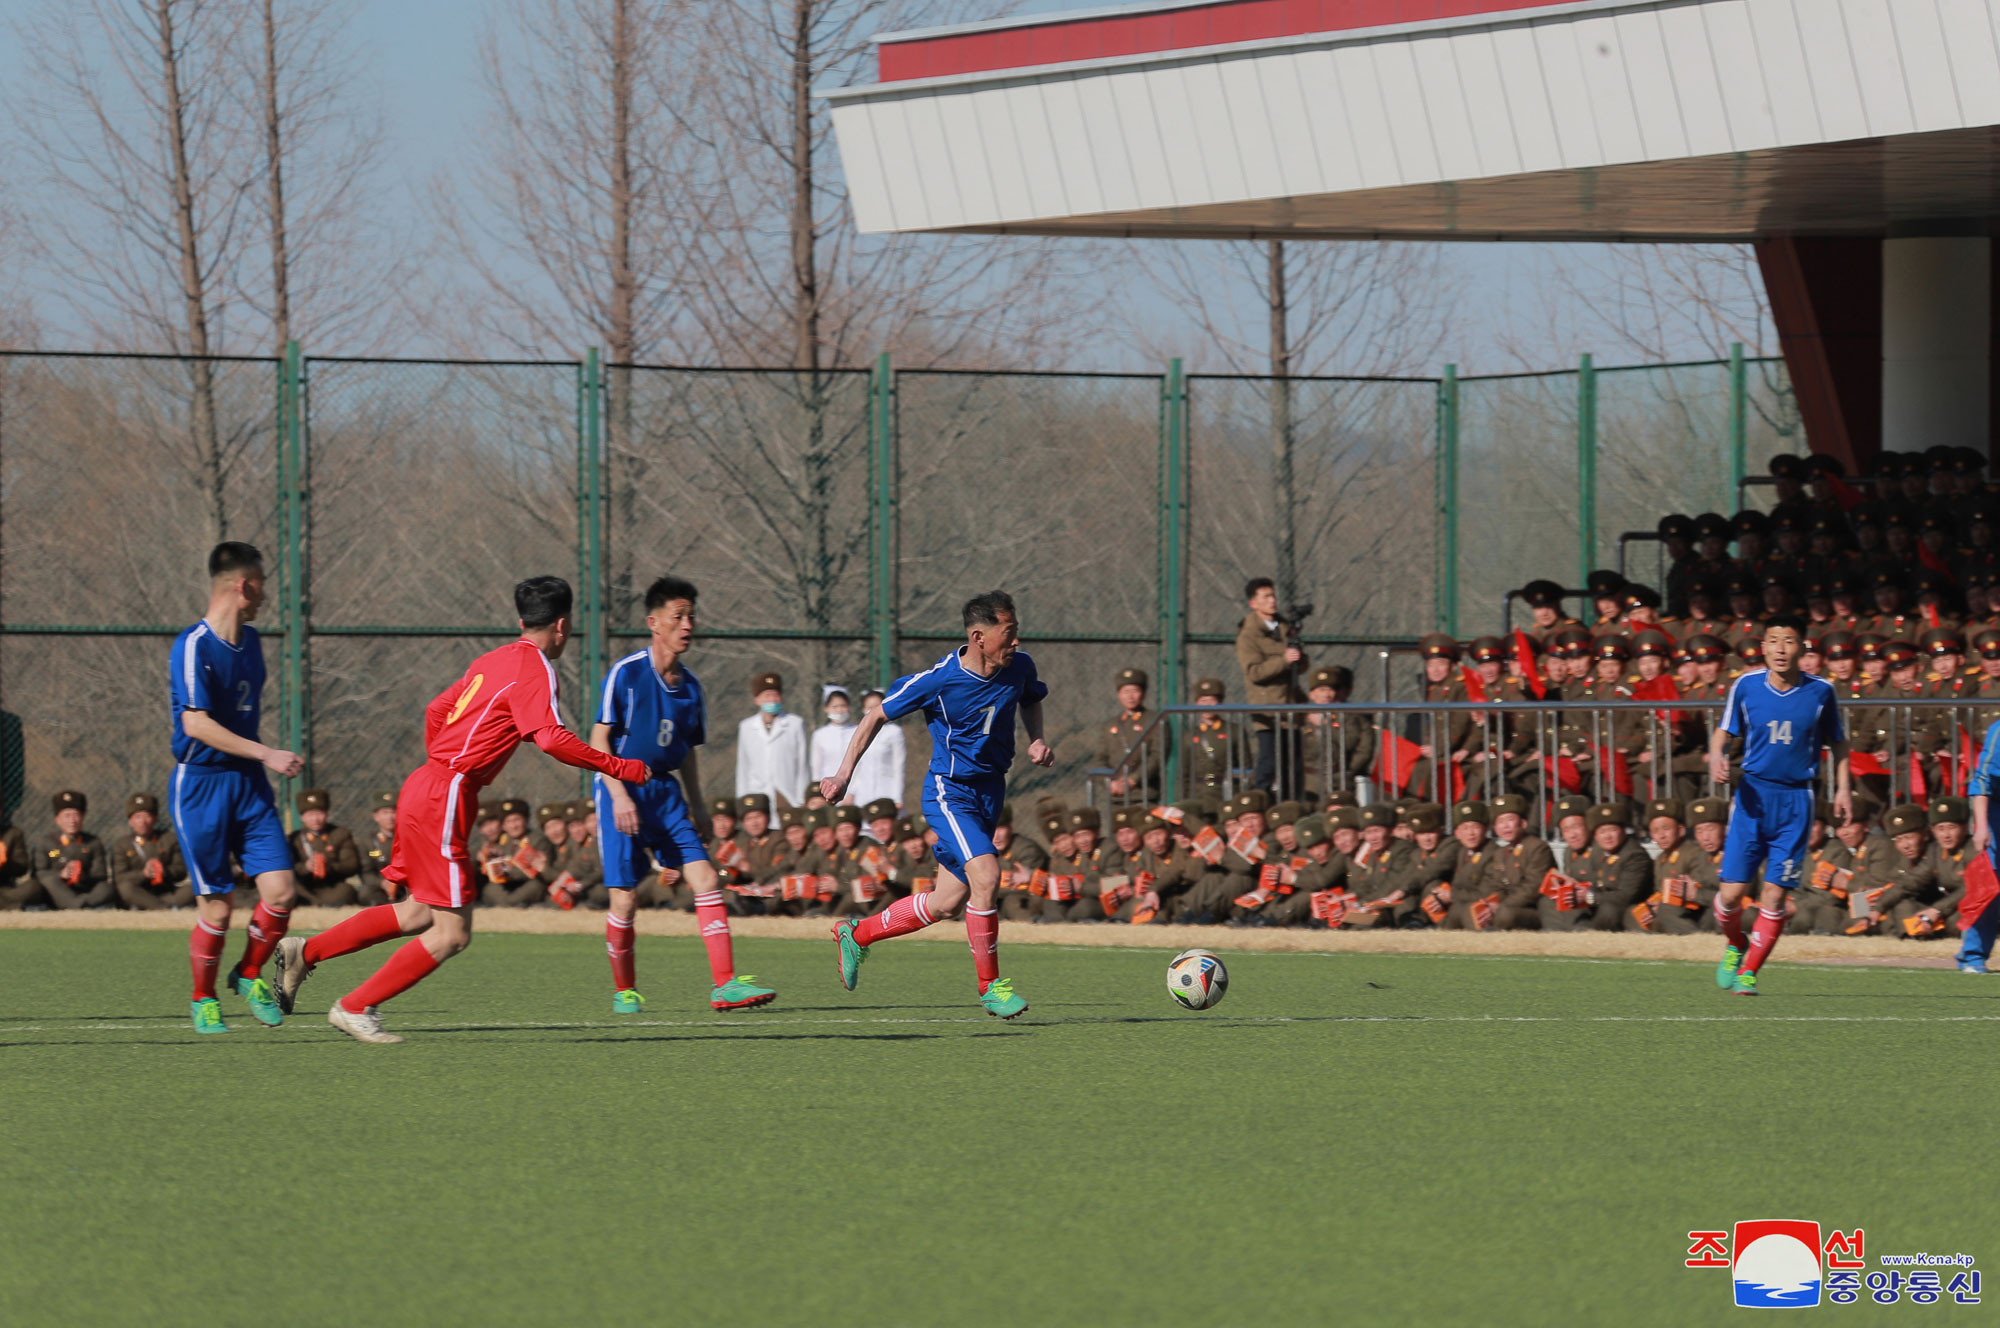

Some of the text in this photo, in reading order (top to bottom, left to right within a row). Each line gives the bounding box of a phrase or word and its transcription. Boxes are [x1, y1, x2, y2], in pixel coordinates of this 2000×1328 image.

[236, 680, 252, 711] 2
[447, 673, 484, 725] 9
[656, 718, 674, 747] 8
[980, 706, 996, 734] 7
[1766, 720, 1793, 744] 14
[1781, 858, 1802, 882] 1
